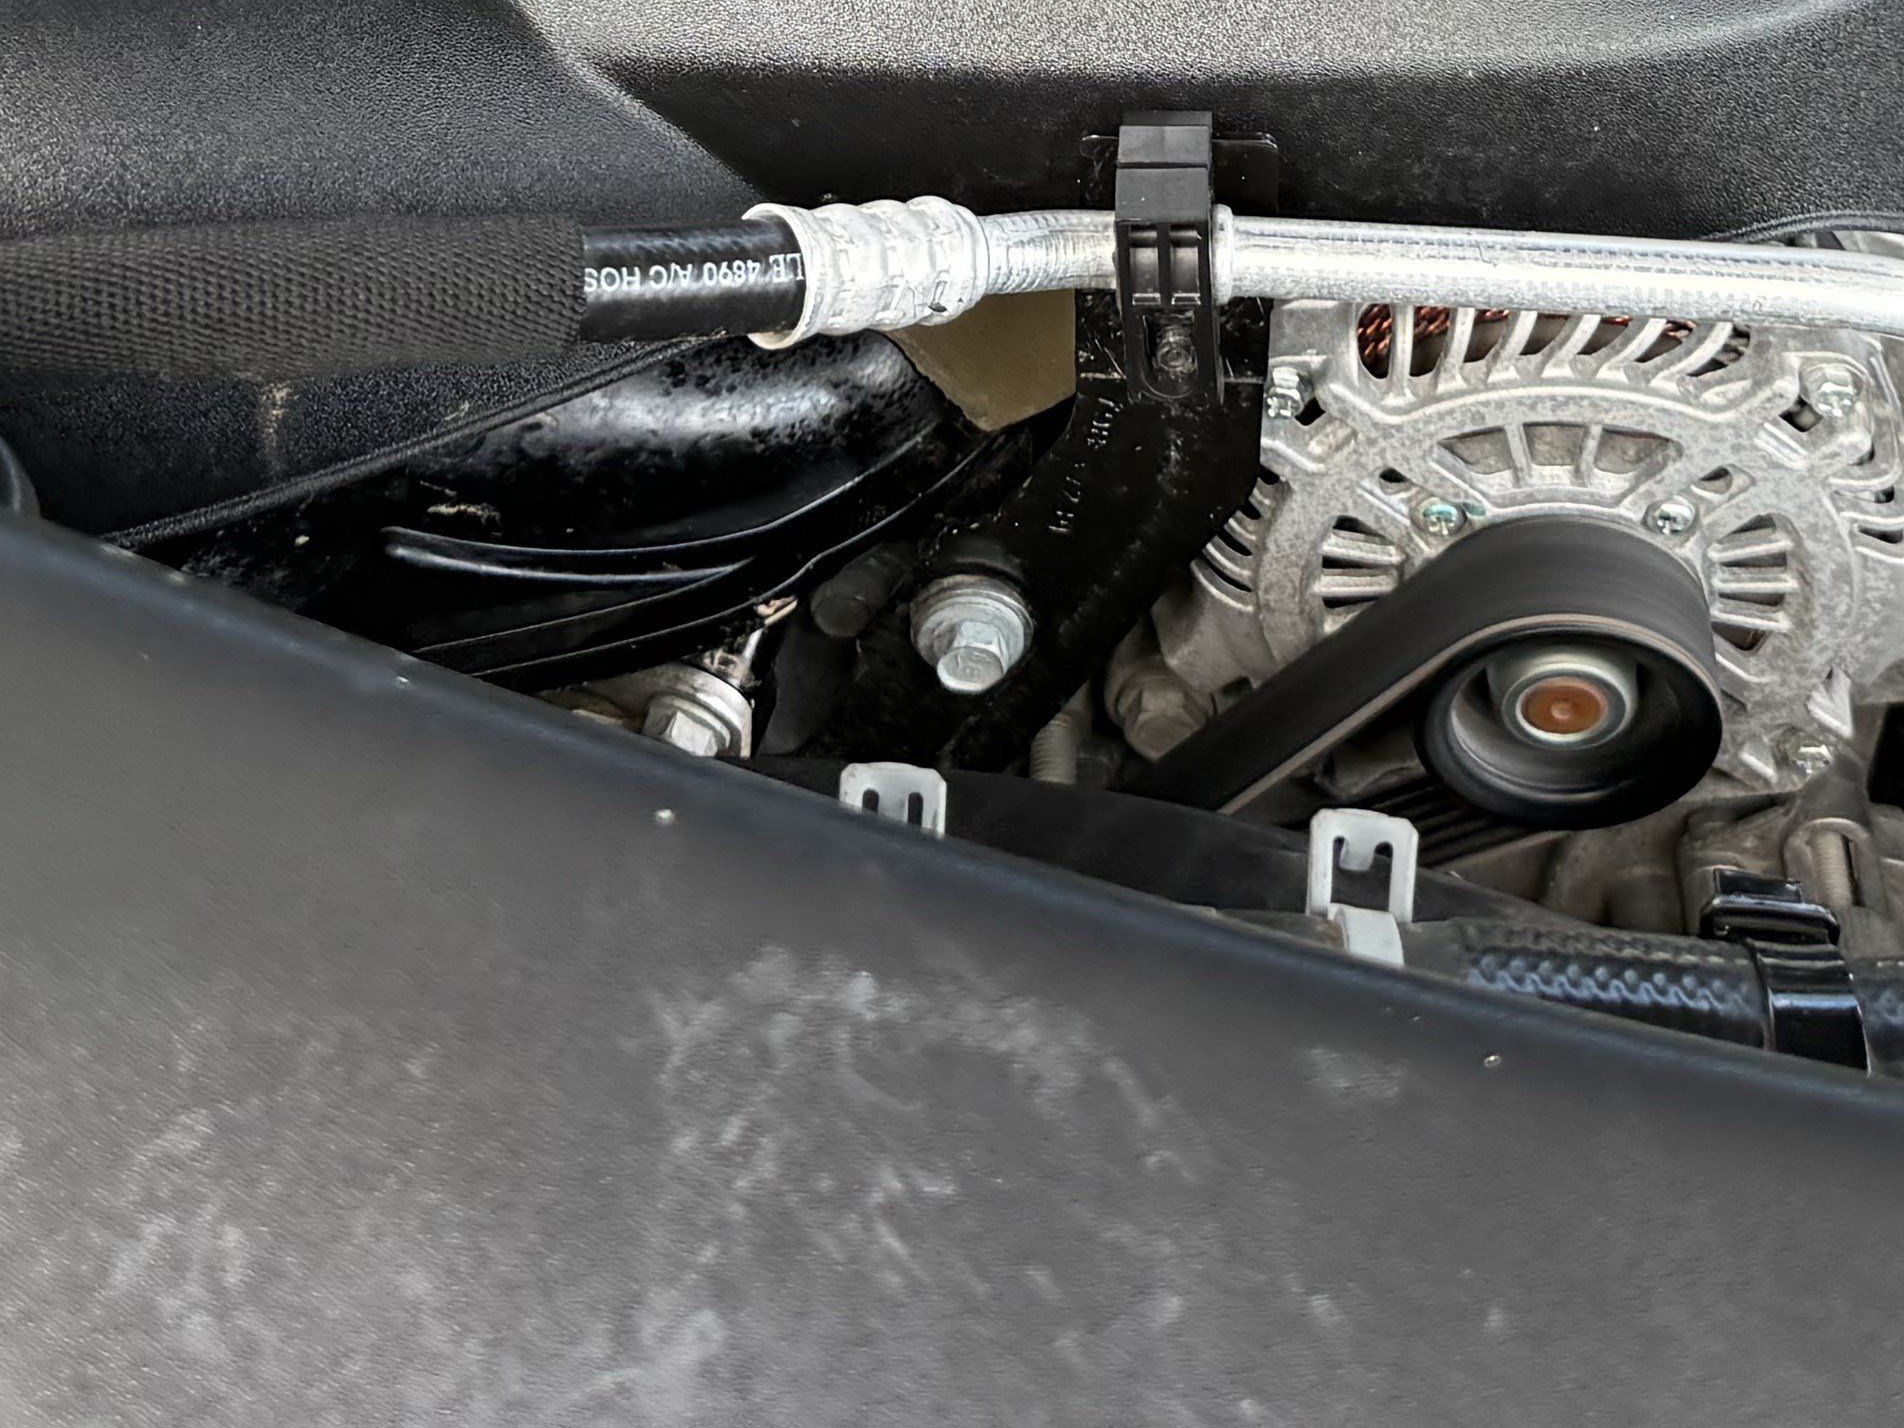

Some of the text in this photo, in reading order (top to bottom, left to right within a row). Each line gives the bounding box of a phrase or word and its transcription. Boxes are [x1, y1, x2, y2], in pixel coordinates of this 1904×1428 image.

[584, 252, 805, 293] LE 4890 A/C HOS
